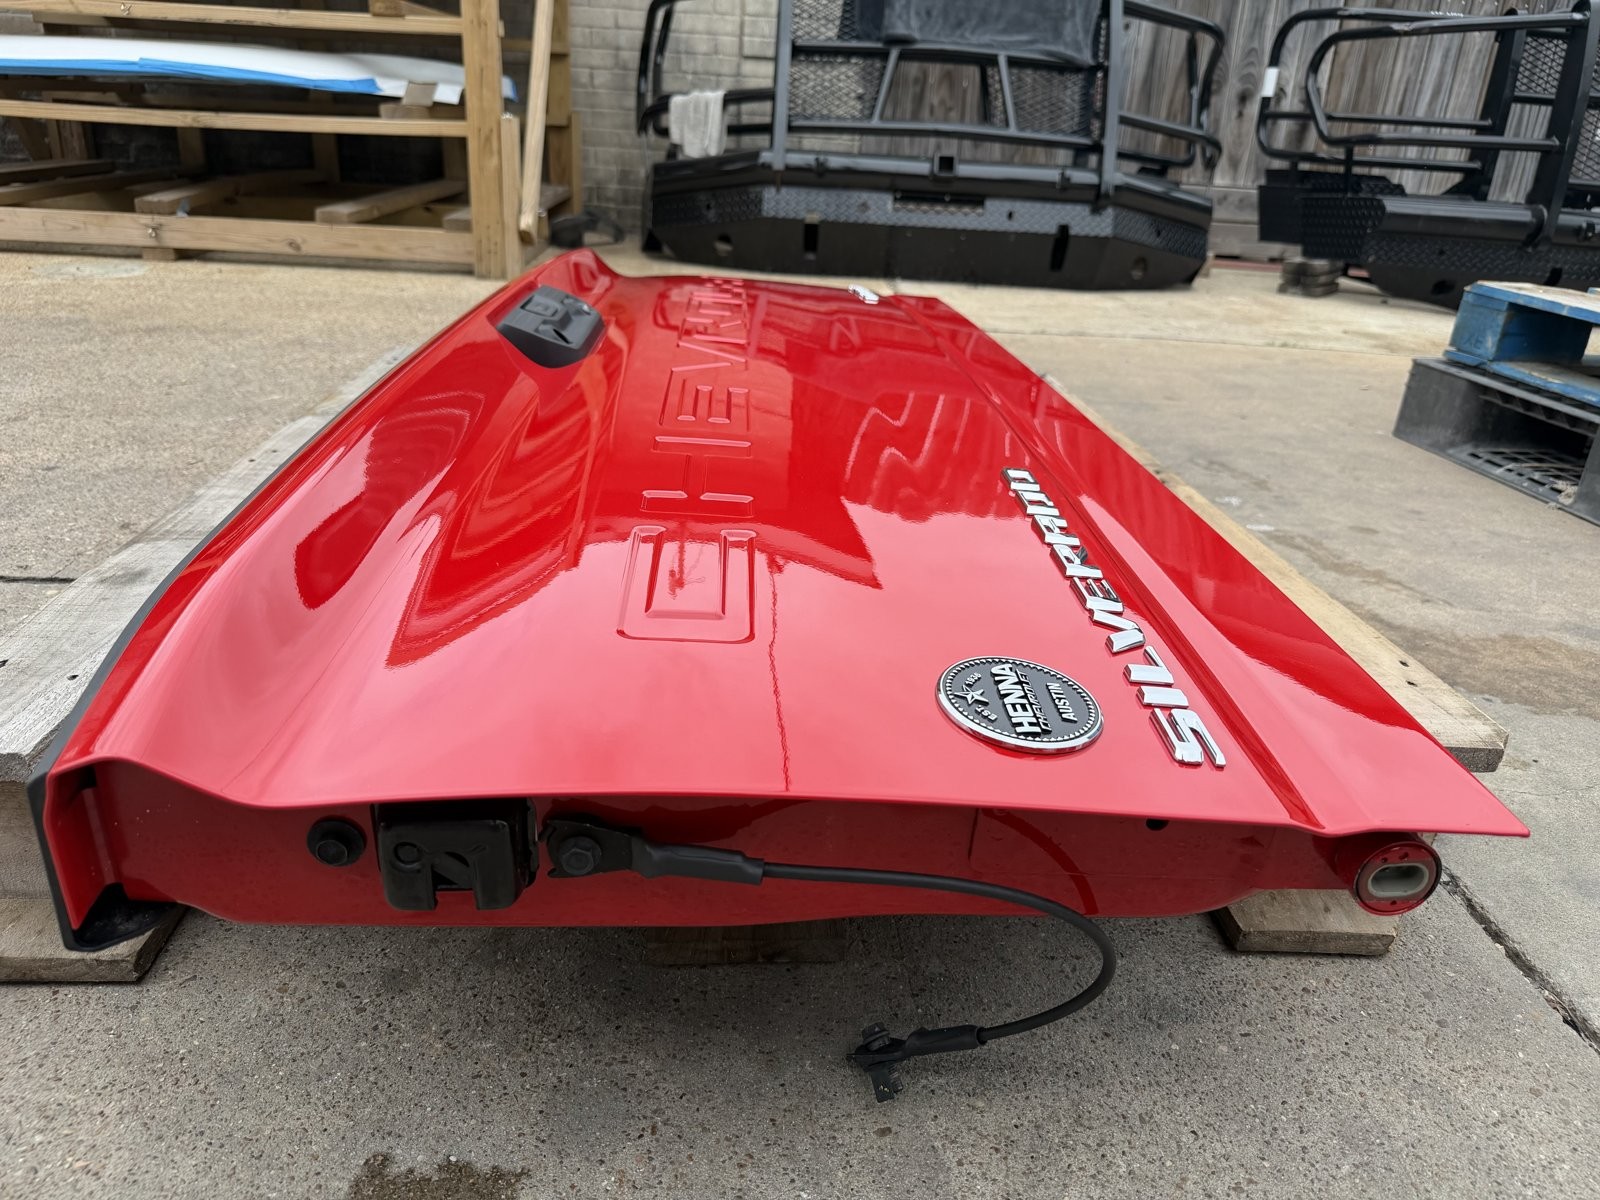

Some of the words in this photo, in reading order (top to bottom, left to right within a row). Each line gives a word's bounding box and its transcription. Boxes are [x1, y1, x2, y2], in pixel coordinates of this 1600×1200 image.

[1001, 468, 1226, 767] SILVERADO
[991, 663, 1042, 734] HENNA
[1016, 669, 1052, 732] CHEVROLET
[1047, 682, 1078, 722] AUSTIN
